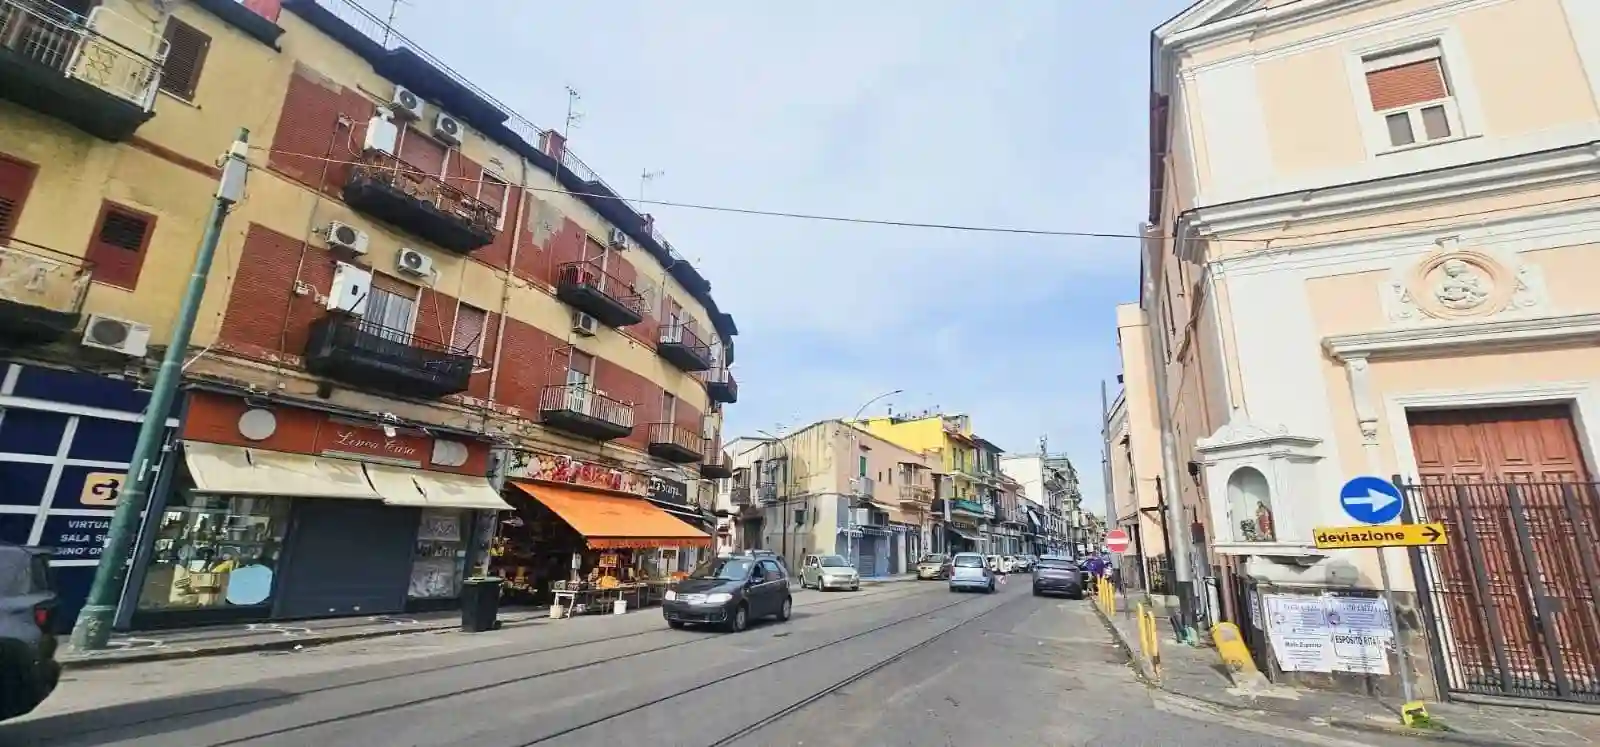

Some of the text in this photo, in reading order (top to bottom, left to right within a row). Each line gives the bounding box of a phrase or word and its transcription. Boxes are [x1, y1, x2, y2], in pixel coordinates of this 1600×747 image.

[68, 520, 109, 529] VIRTUA
[60, 534, 90, 543] SALA
[1317, 530, 1405, 543] deviazione
